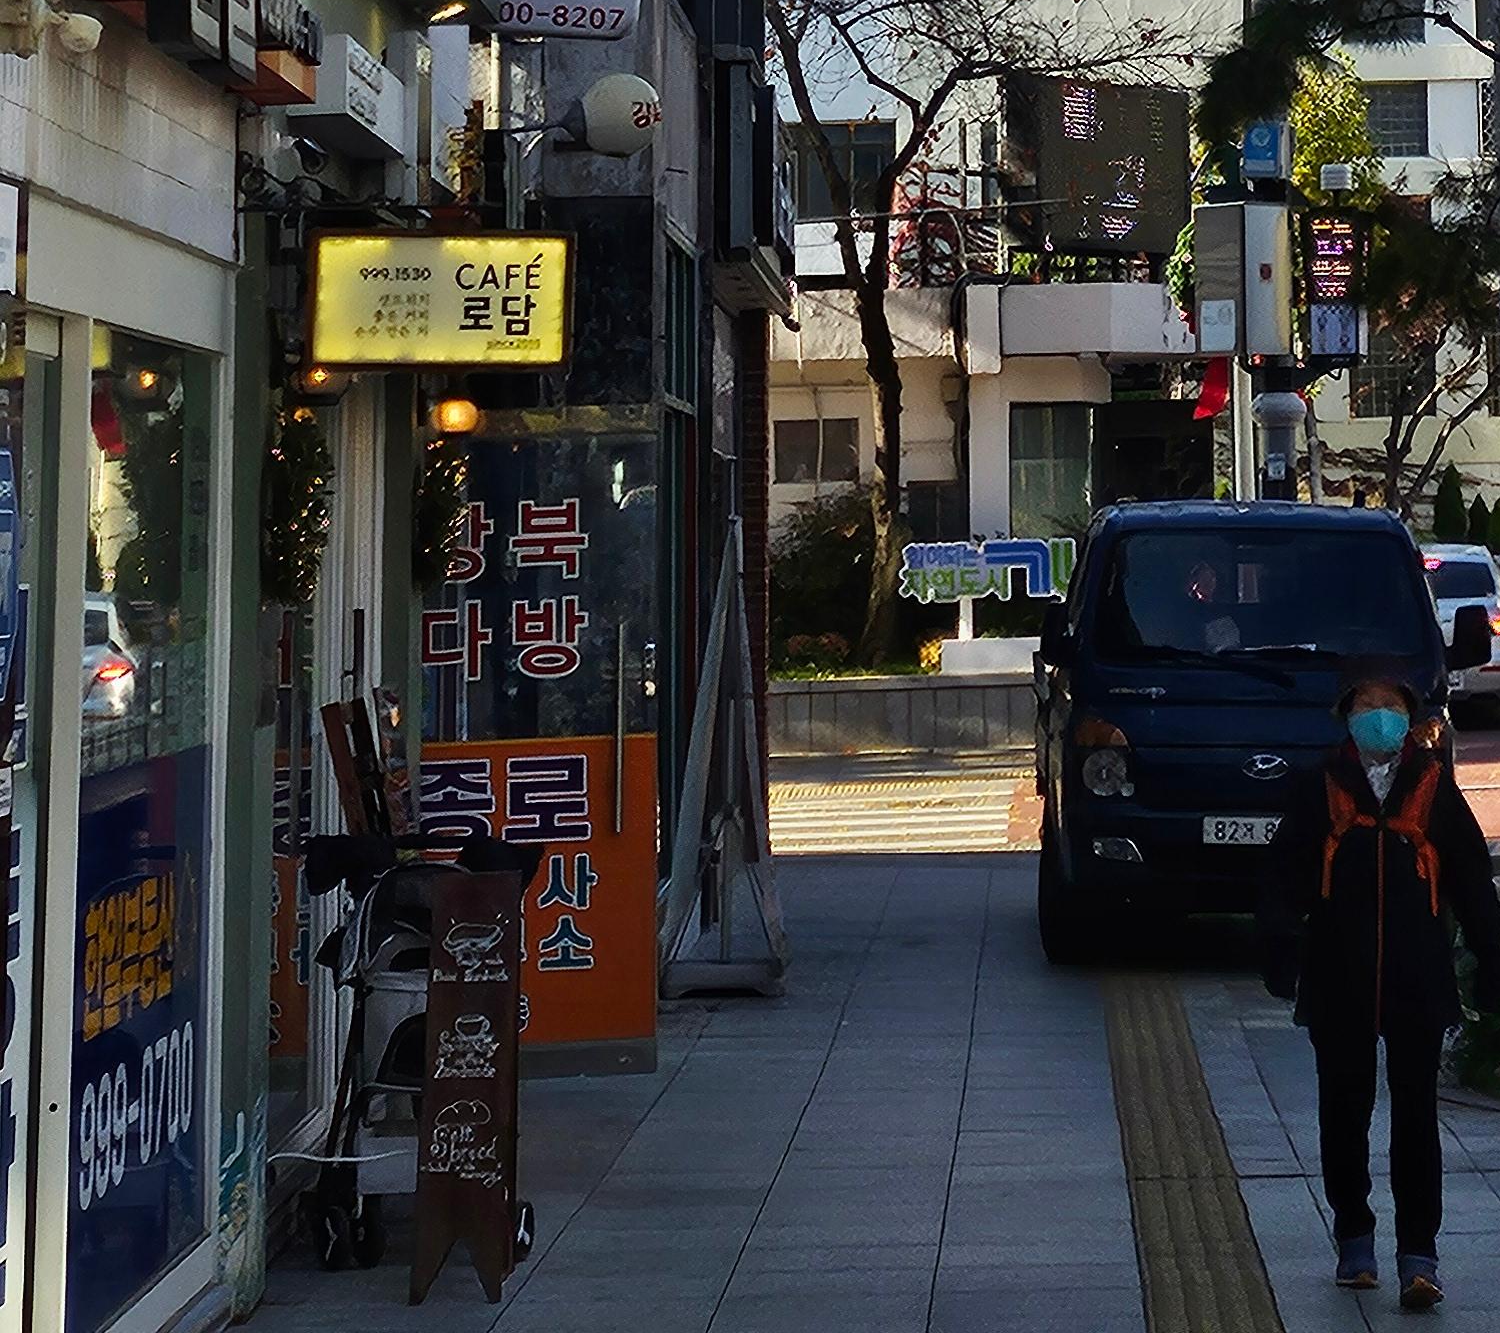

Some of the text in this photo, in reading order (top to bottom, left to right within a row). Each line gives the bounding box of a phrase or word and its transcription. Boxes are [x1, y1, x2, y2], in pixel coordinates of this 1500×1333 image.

[500, 1, 626, 31] 00-8207
[455, 252, 544, 291] CAFÉ
[458, 293, 538, 337] 로담
[421, 594, 590, 680] 다방
[79, 1020, 194, 1211] 999-0700
